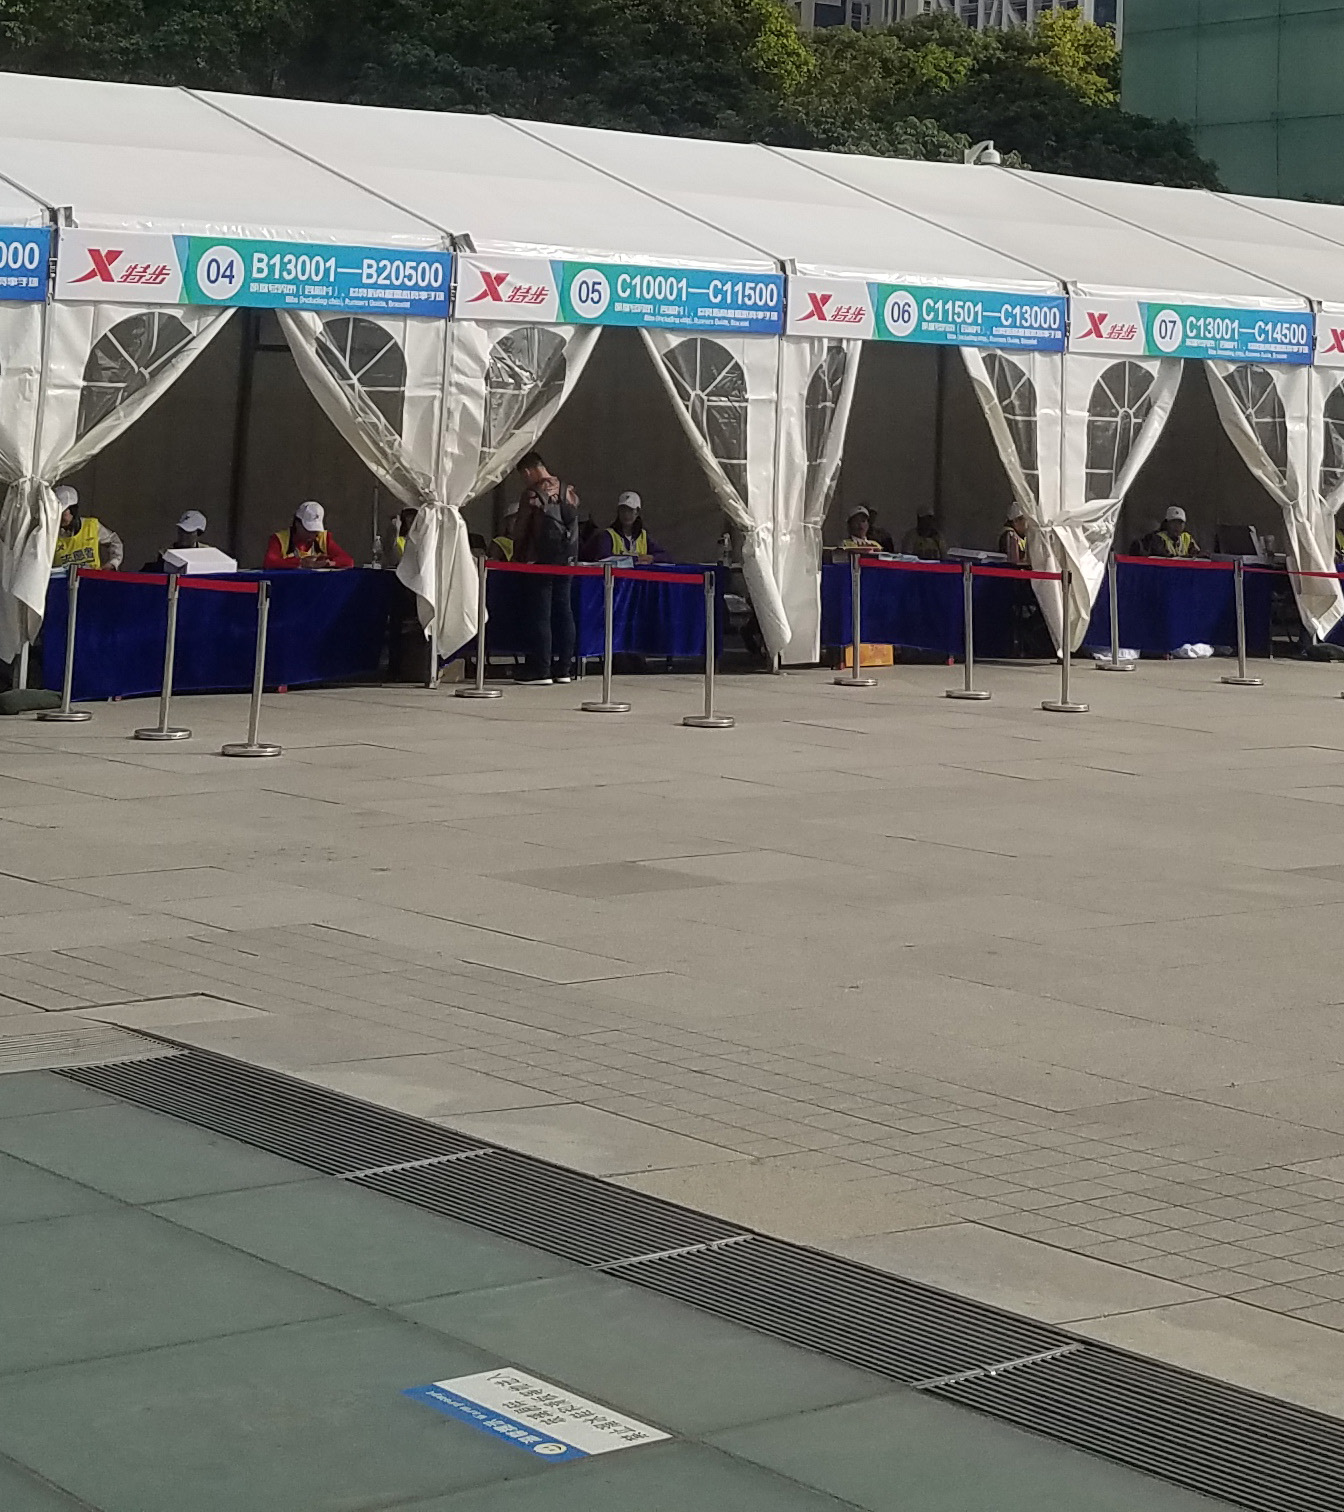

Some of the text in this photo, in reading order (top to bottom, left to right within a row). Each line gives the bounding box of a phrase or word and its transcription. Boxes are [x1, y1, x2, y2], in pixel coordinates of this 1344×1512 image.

[117, 263, 171, 285] 特步
[206, 259, 236, 285] 04
[505, 285, 550, 304] 特步
[578, 279, 602, 305] 05
[890, 302, 912, 324] 06
[1158, 319, 1177, 340] 07
